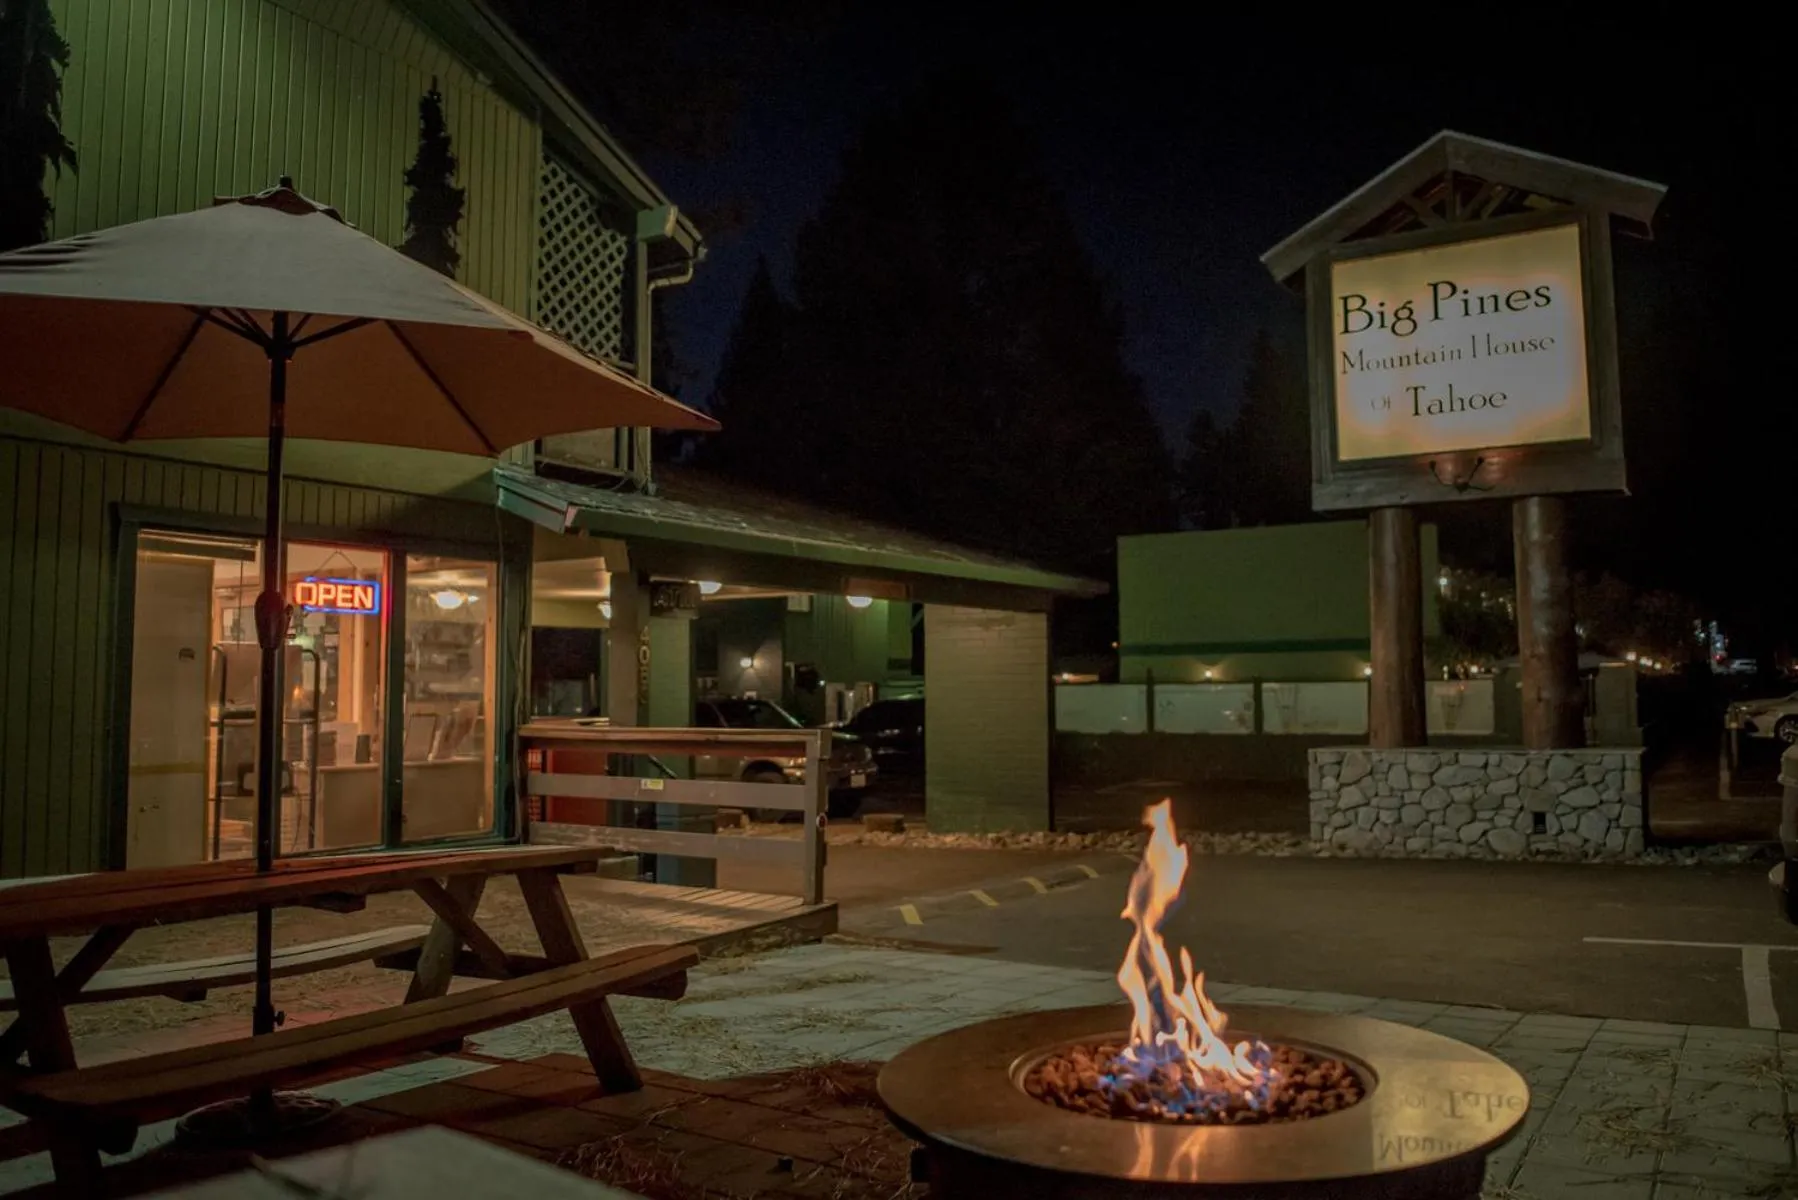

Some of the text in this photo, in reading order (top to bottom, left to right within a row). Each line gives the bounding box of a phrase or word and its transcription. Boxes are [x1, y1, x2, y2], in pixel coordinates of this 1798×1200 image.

[1338, 280, 1551, 337] Big Pines
[1340, 333, 1555, 375] Mountain House
[1405, 383, 1507, 417] Tahoe
[295, 582, 374, 609] OPEN
